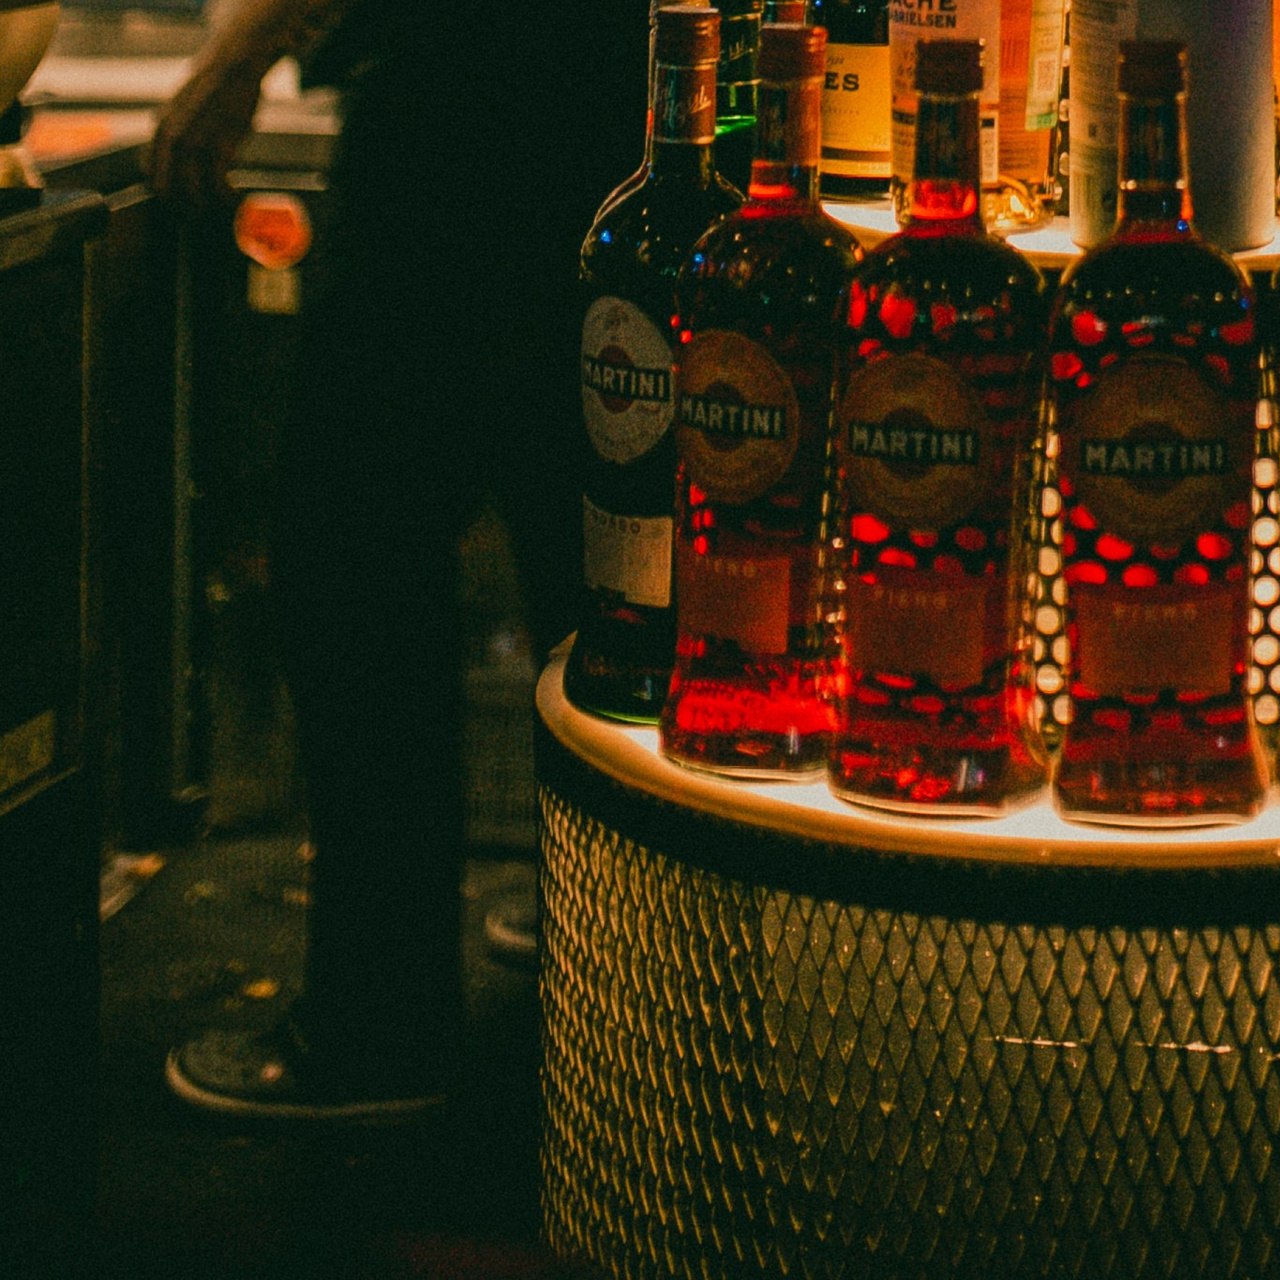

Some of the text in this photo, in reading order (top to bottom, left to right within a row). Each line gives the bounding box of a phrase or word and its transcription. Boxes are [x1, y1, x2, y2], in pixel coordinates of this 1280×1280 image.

[680, 396, 782, 438] MARTINI
[851, 424, 975, 459] MARTINI
[1085, 443, 1225, 473] MARTINI
